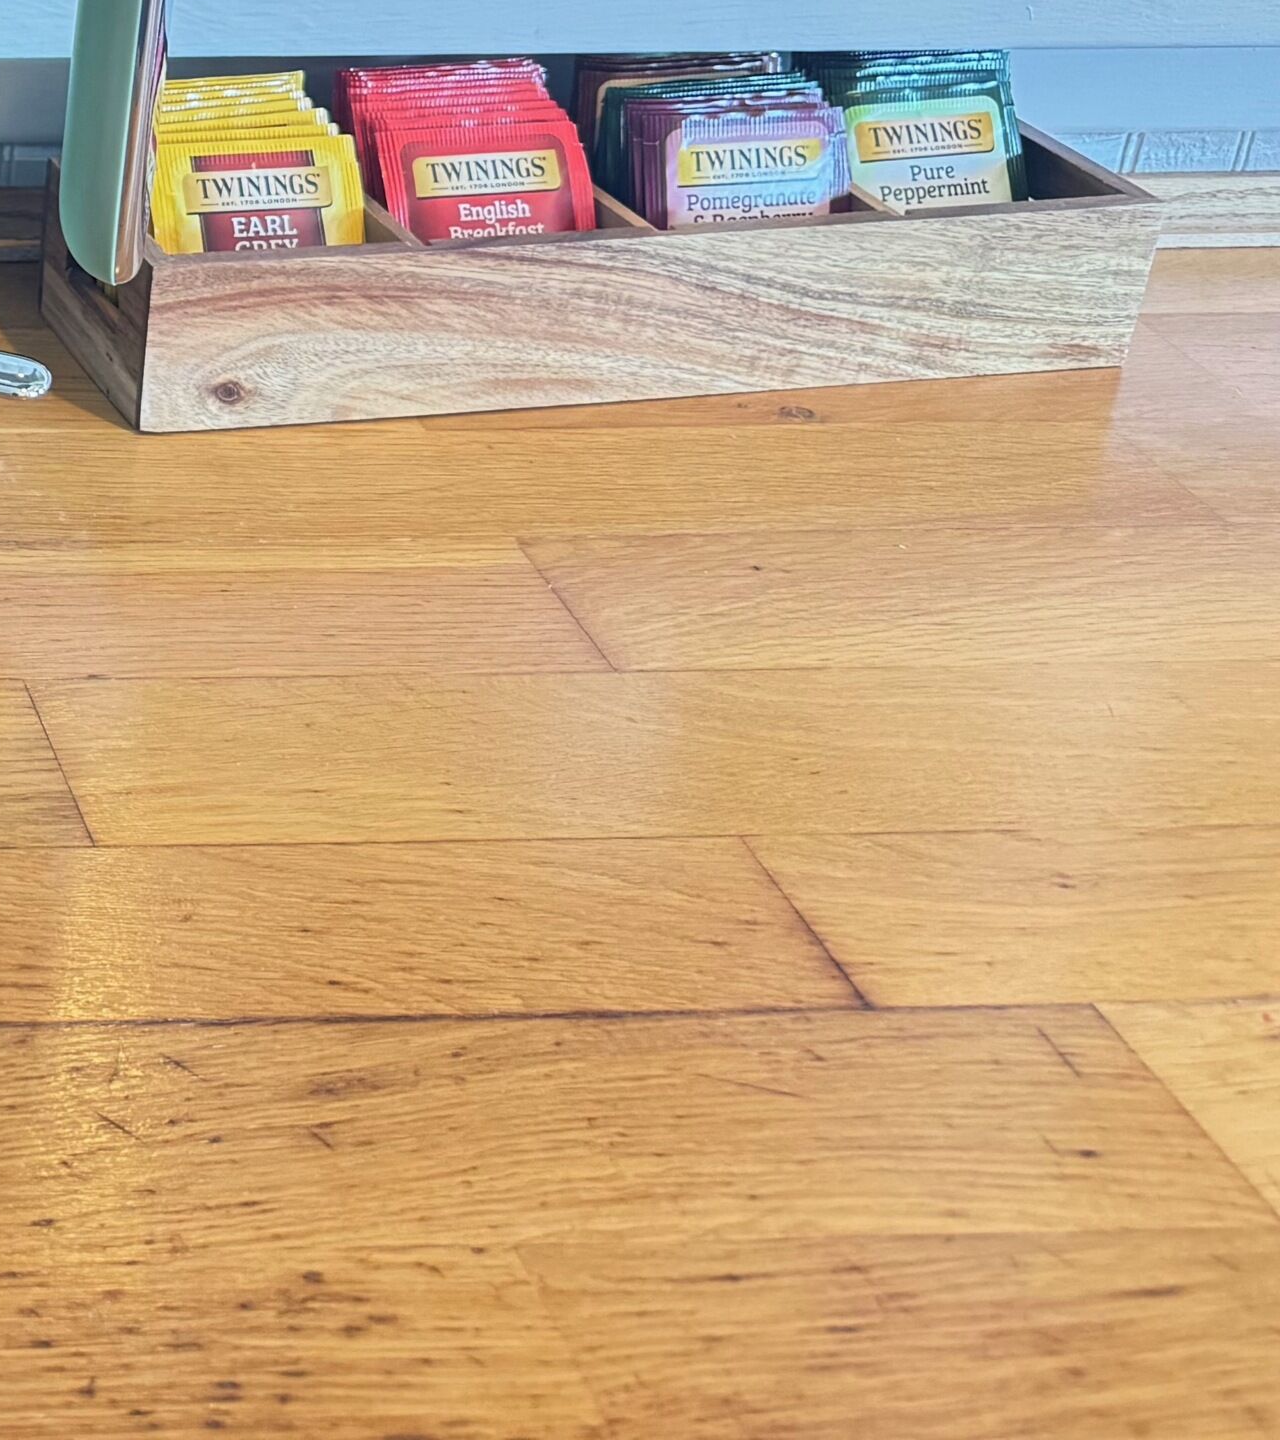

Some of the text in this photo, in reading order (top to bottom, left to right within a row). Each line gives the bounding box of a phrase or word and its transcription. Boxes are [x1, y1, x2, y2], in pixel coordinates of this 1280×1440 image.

[868, 118, 982, 148] TWININGS
[426, 156, 547, 184] TWININGS
[691, 144, 808, 172] TWININGS
[196, 173, 320, 200] TWININGS
[910, 164, 956, 182] Pure
[686, 190, 817, 213] Pomegranate
[880, 177, 991, 205] Peppermint
[458, 199, 532, 225] English
[231, 215, 298, 238] EARL
